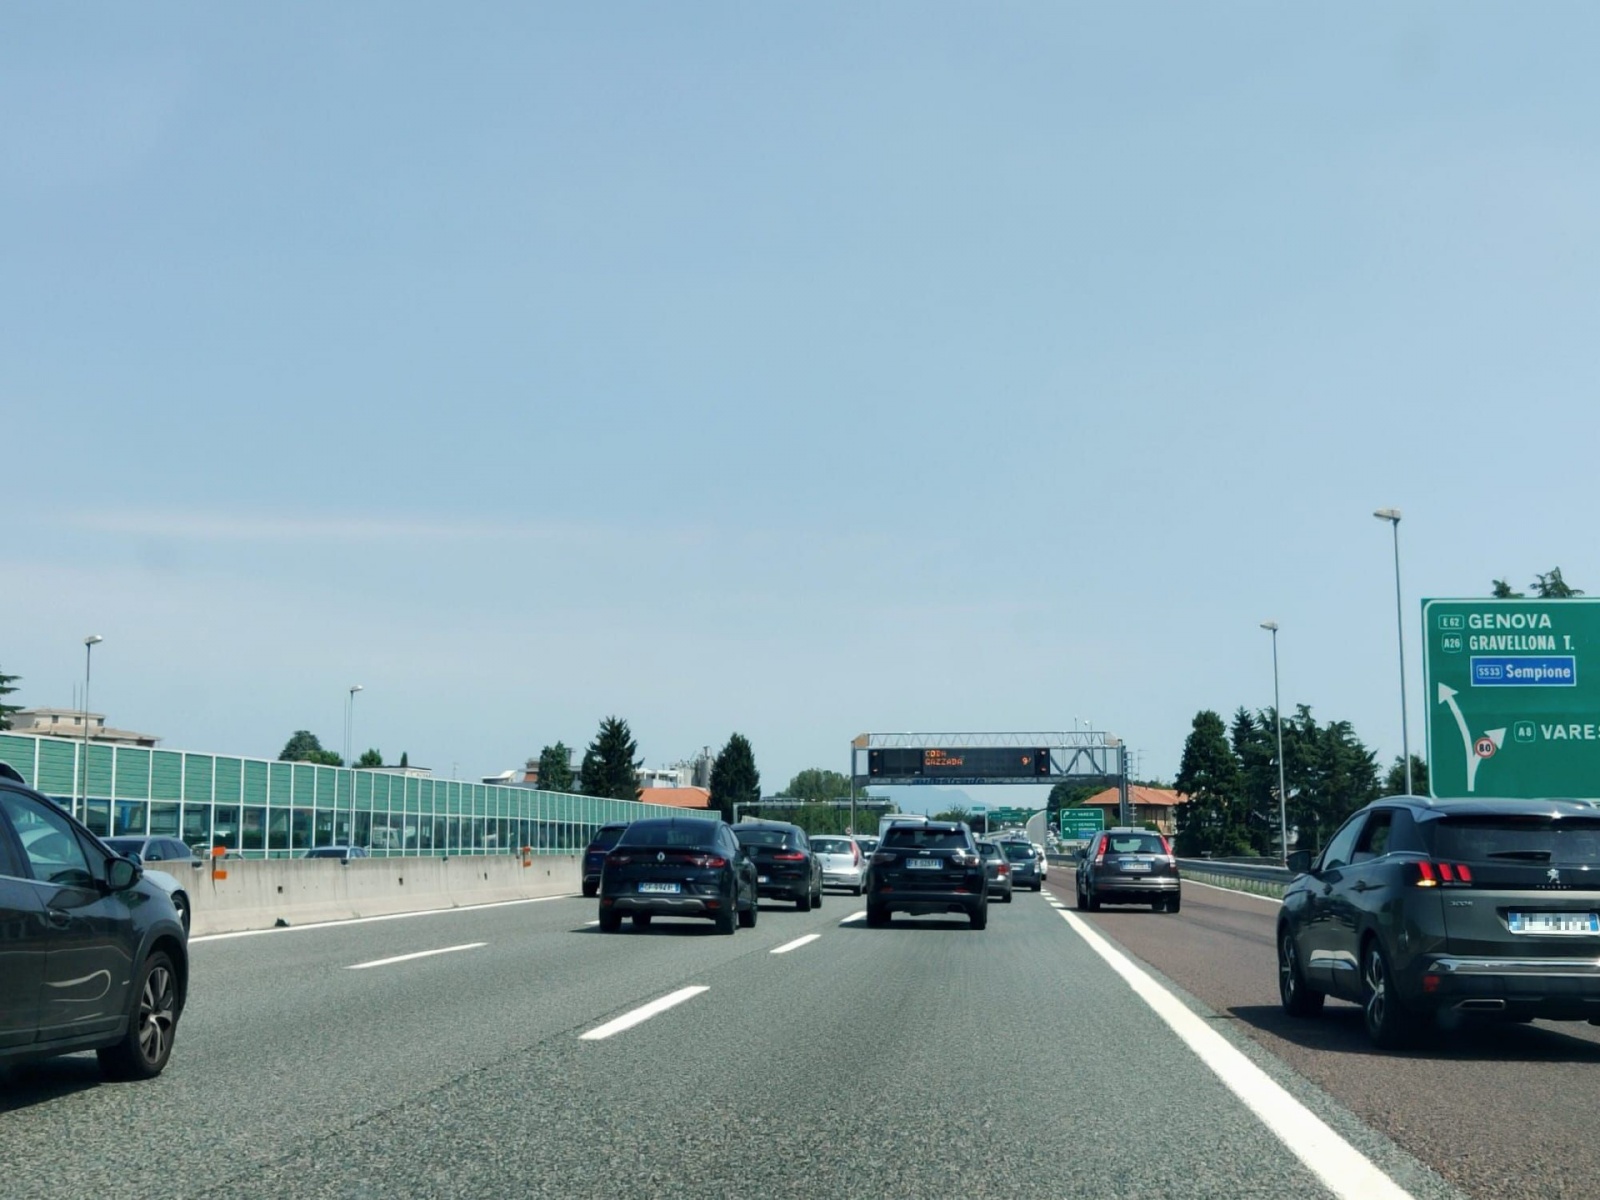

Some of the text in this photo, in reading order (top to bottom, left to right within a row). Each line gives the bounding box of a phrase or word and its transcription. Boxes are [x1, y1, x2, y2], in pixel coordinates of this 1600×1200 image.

[1468, 613, 1552, 629] GENOVA
[1444, 638, 1461, 648] A26
[1469, 635, 1575, 651] GRAVELLONA T.
[1478, 667, 1501, 676] SS33
[1506, 664, 1571, 681] Sempione
[1479, 743, 1491, 752] 80
